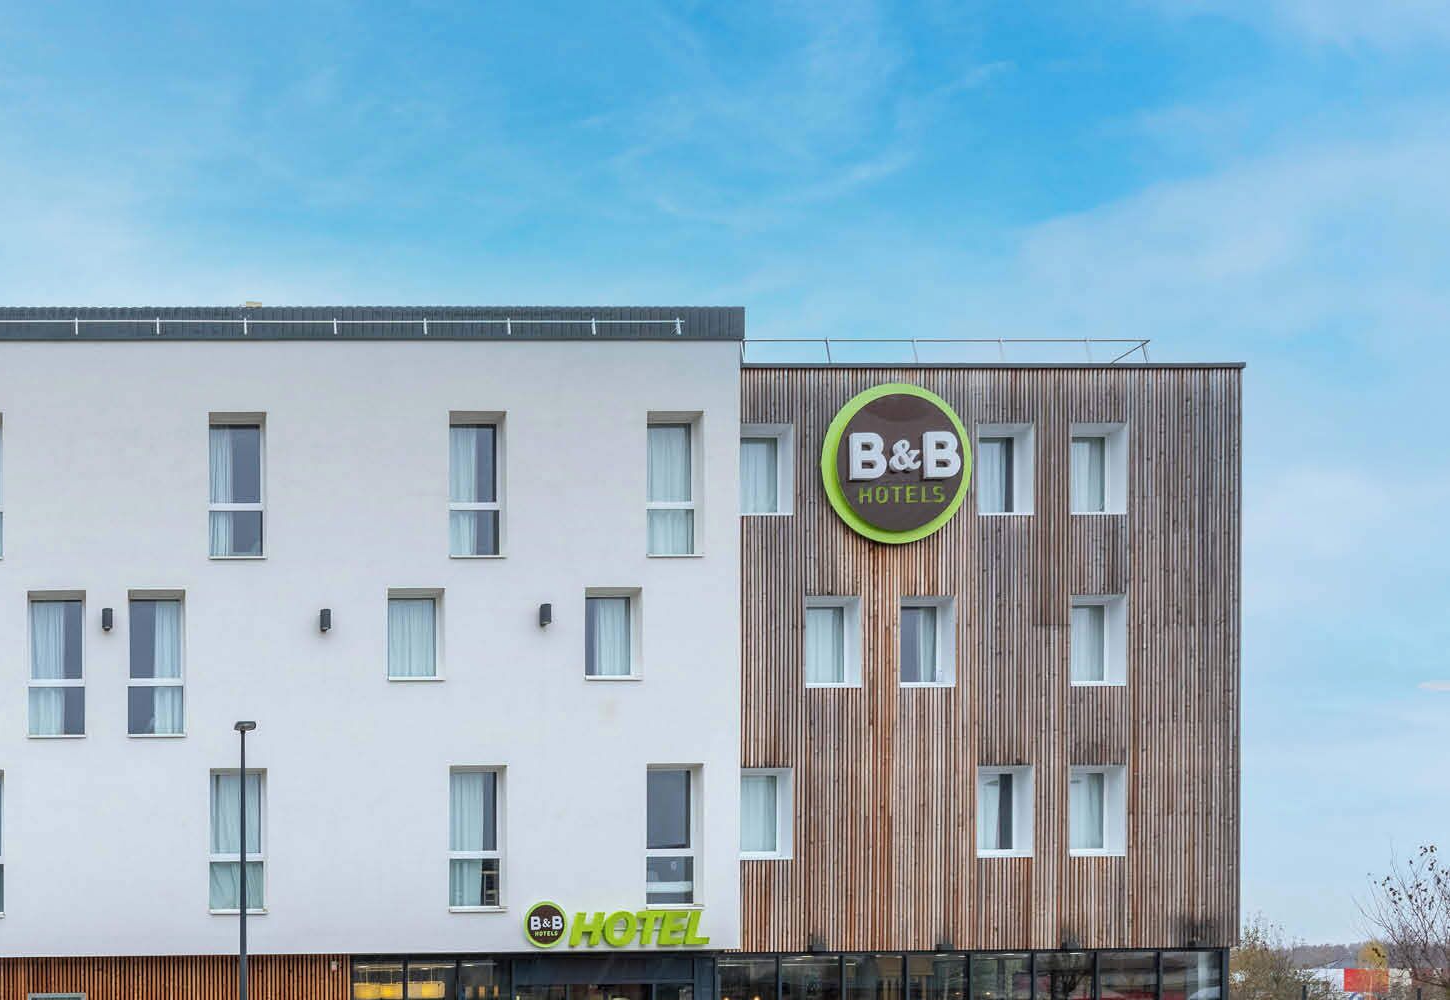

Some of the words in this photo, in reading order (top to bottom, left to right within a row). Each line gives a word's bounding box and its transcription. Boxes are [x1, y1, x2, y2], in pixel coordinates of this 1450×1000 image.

[848, 431, 961, 481] B&B
[858, 486, 946, 504] HOTELS
[530, 916, 563, 930] B&B
[569, 910, 710, 946] HOTEL
